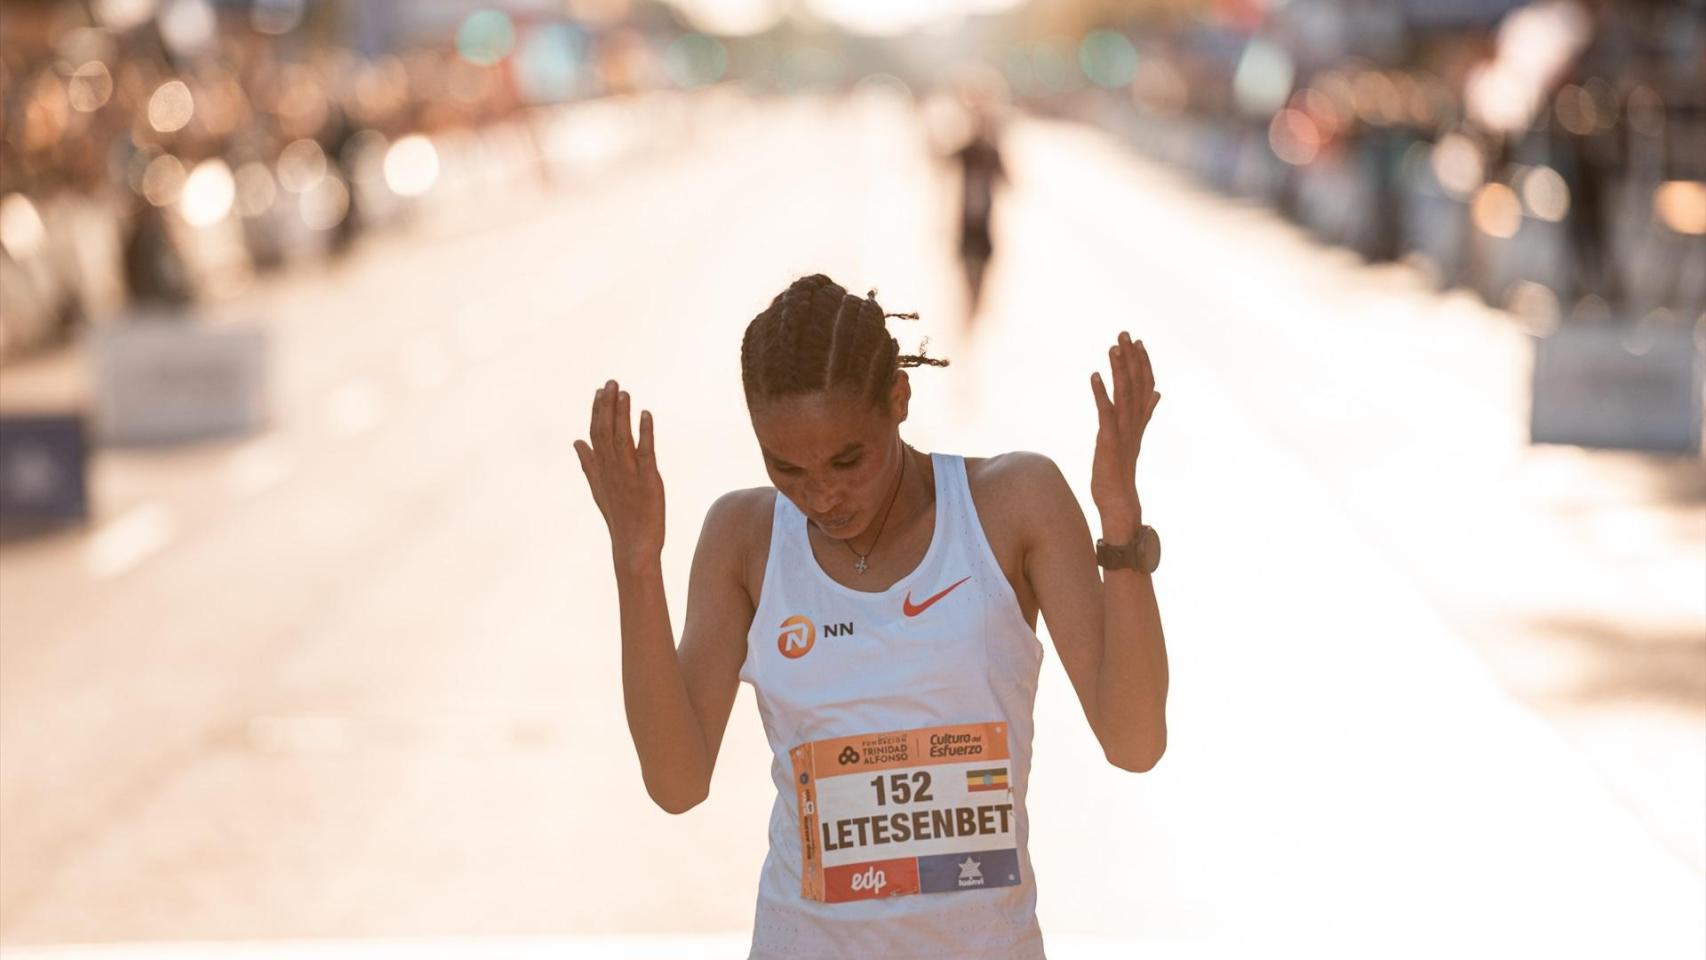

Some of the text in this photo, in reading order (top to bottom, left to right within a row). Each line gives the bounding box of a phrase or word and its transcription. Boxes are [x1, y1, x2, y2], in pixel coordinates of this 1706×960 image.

[823, 622, 854, 638] NN
[930, 733, 971, 746] Cultura
[862, 744, 908, 756] TRINIDAD
[930, 744, 983, 757] Esfuerzo
[863, 752, 909, 765] ALFONSO
[870, 771, 934, 806] 152
[822, 803, 1013, 851] LETESENBET
[851, 866, 887, 895] edp
